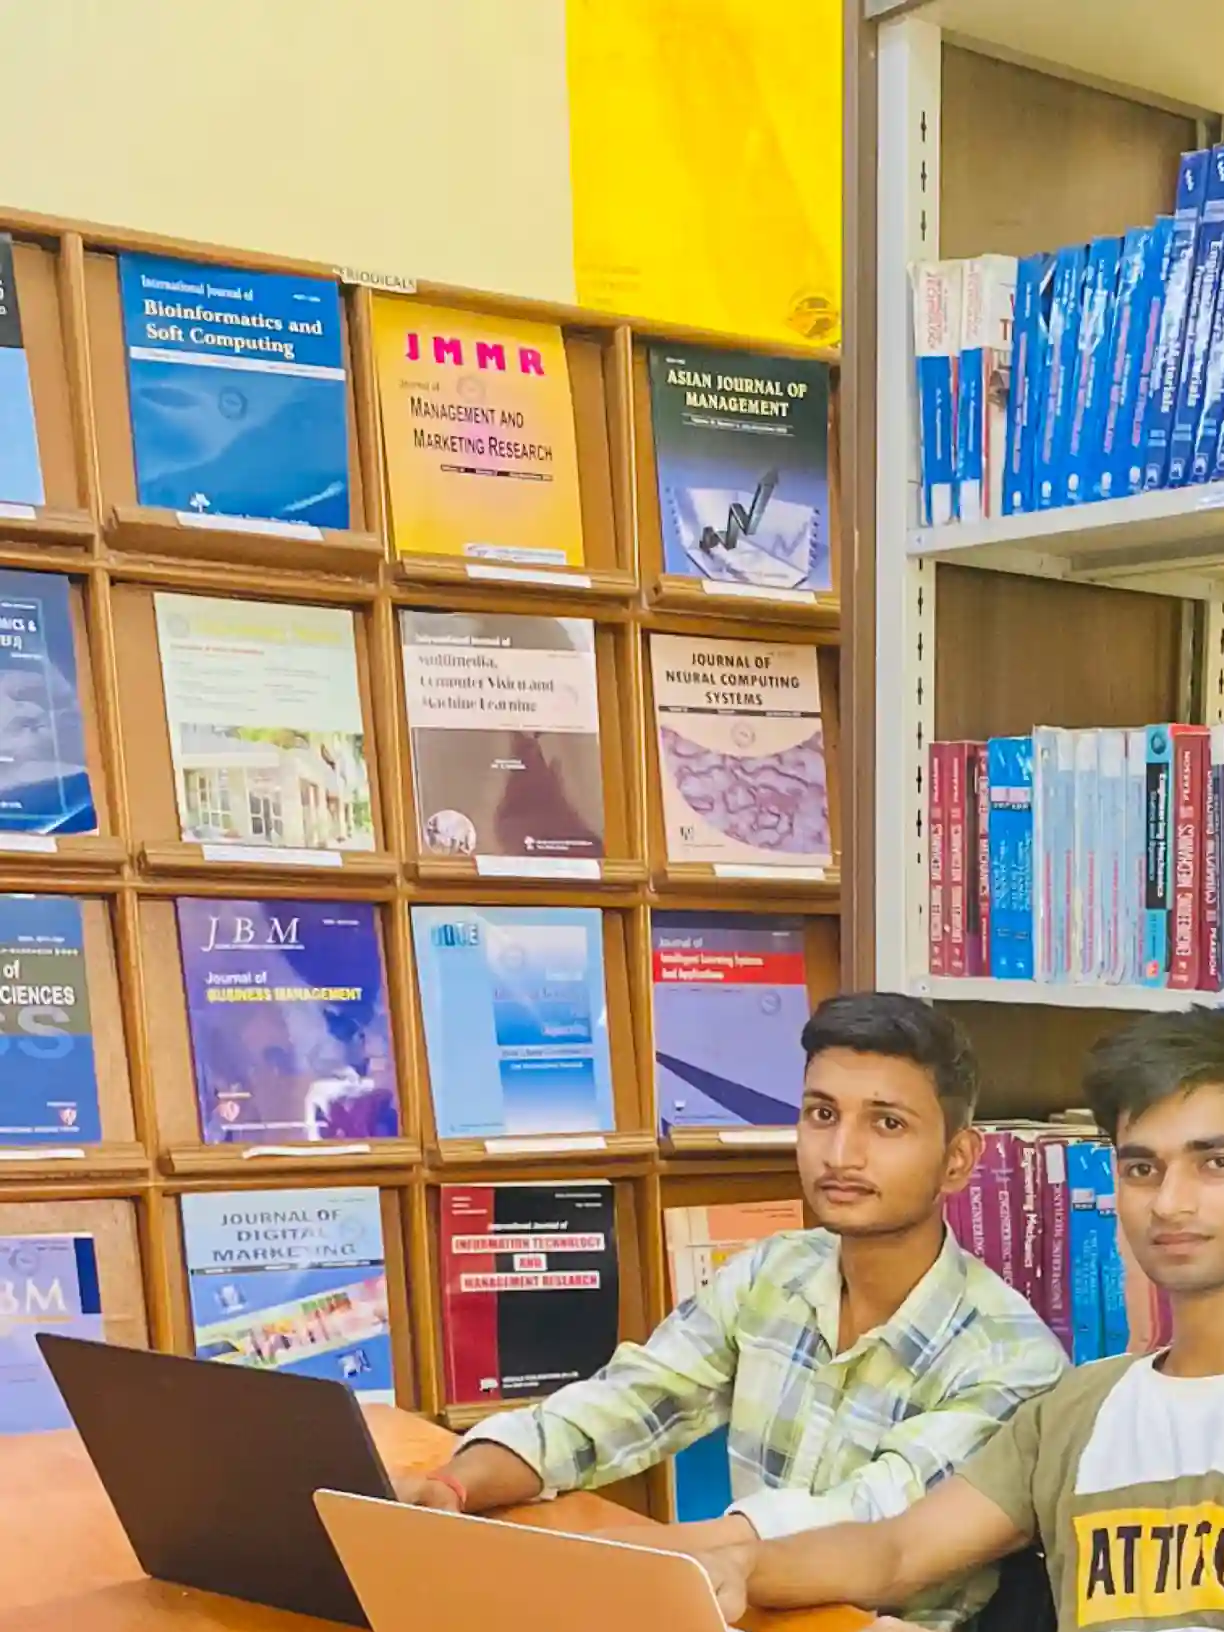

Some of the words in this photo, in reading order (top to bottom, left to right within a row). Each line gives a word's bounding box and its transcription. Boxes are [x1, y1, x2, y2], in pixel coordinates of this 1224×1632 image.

[144, 299, 283, 330] Bioinformatics
[288, 320, 323, 335] and
[146, 323, 184, 341] Soft
[190, 328, 295, 359] Computing
[666, 368, 712, 390] ASIAN
[716, 374, 784, 397] JOURNAL
[787, 381, 807, 399] OF
[410, 396, 496, 423] MANAGEMENT
[499, 411, 524, 428] AND
[685, 391, 789, 417] MANAGEMENT
[413, 428, 485, 456] MARKETING
[488, 435, 553, 462] RESEARCH
[691, 652, 750, 669] JOURNAL
[754, 653, 772, 670] OF
[665, 669, 716, 686] NEURAL
[719, 672, 801, 691] COMPUTING
[704, 690, 764, 707] SYSTEMS
[1176, 823, 1195, 889] MECHANICS
[206, 971, 252, 985] Journal
[254, 971, 267, 985] of
[0, 985, 76, 1006] CIENCES
[1022, 1147, 1036, 1212] Engineering
[220, 1209, 309, 1227] JOURNAL
[317, 1208, 342, 1221] OF
[236, 1227, 327, 1242] DIGITAL
